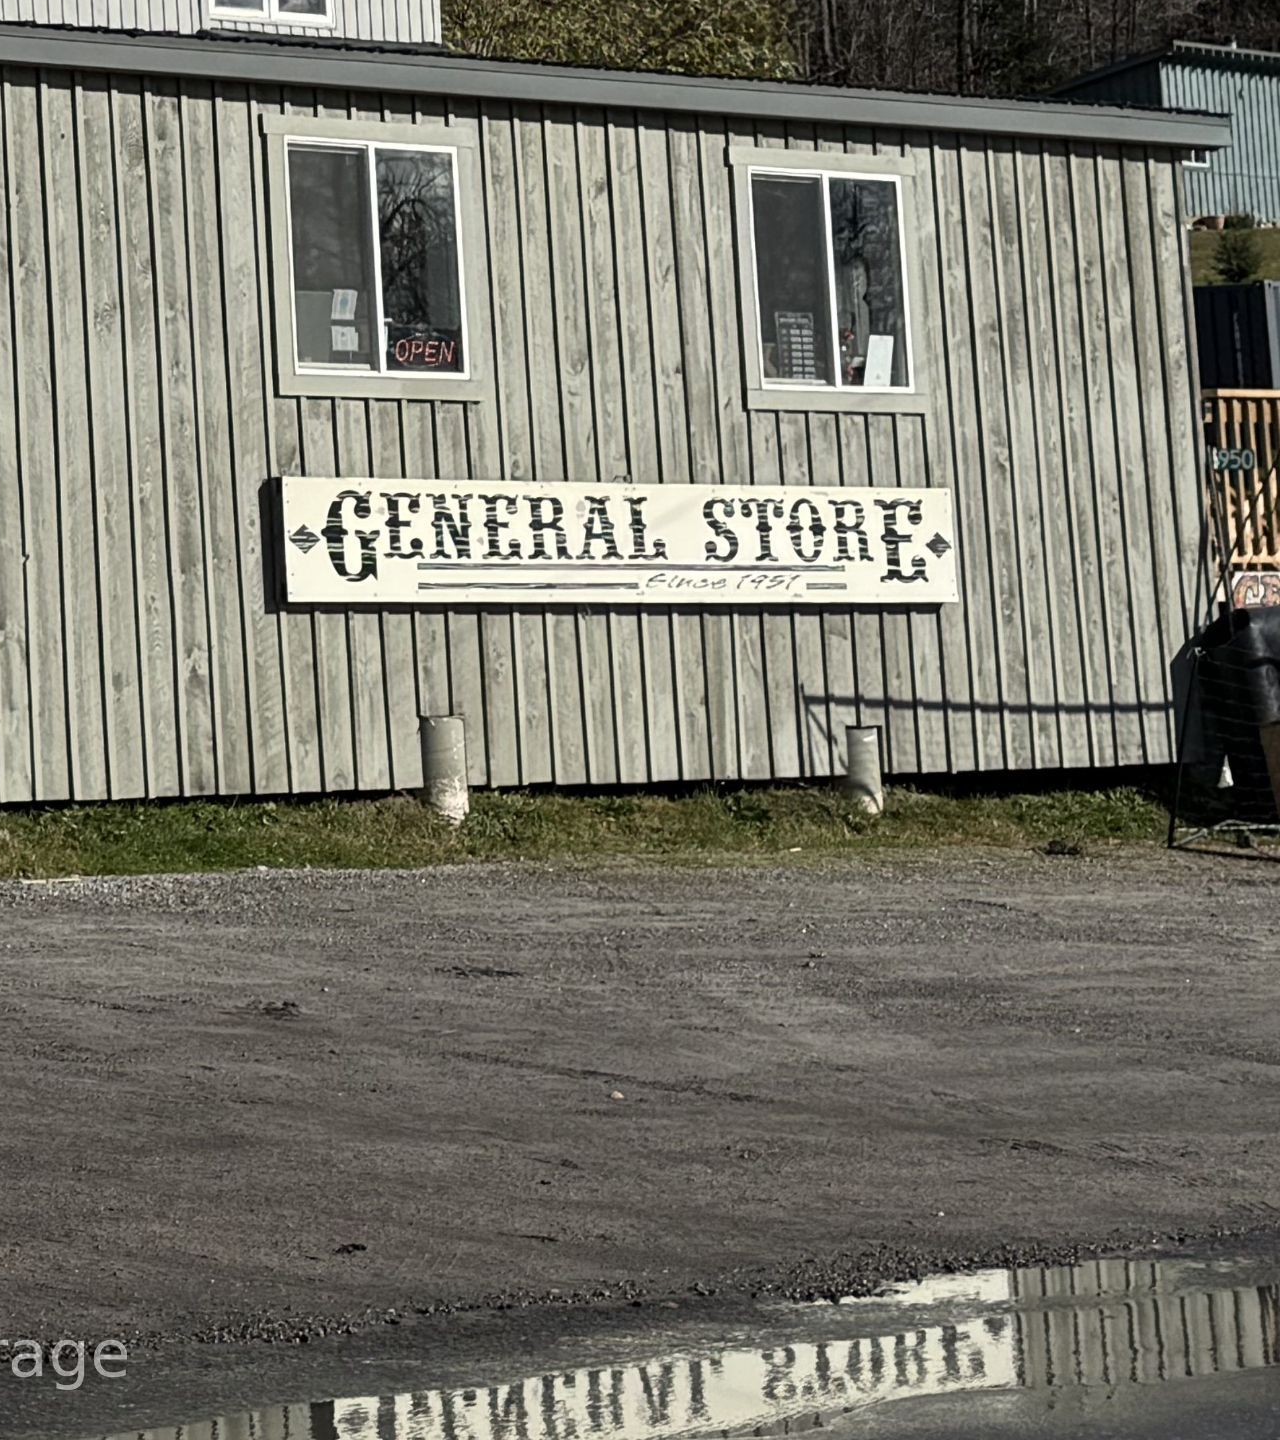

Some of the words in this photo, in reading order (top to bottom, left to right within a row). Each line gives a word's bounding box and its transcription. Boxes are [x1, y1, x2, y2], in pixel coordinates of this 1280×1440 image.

[395, 339, 455, 363] OPEN
[320, 488, 668, 581] GENERAL
[703, 495, 929, 583] STORE
[645, 573, 727, 589] Since
[736, 574, 801, 590] 1951
